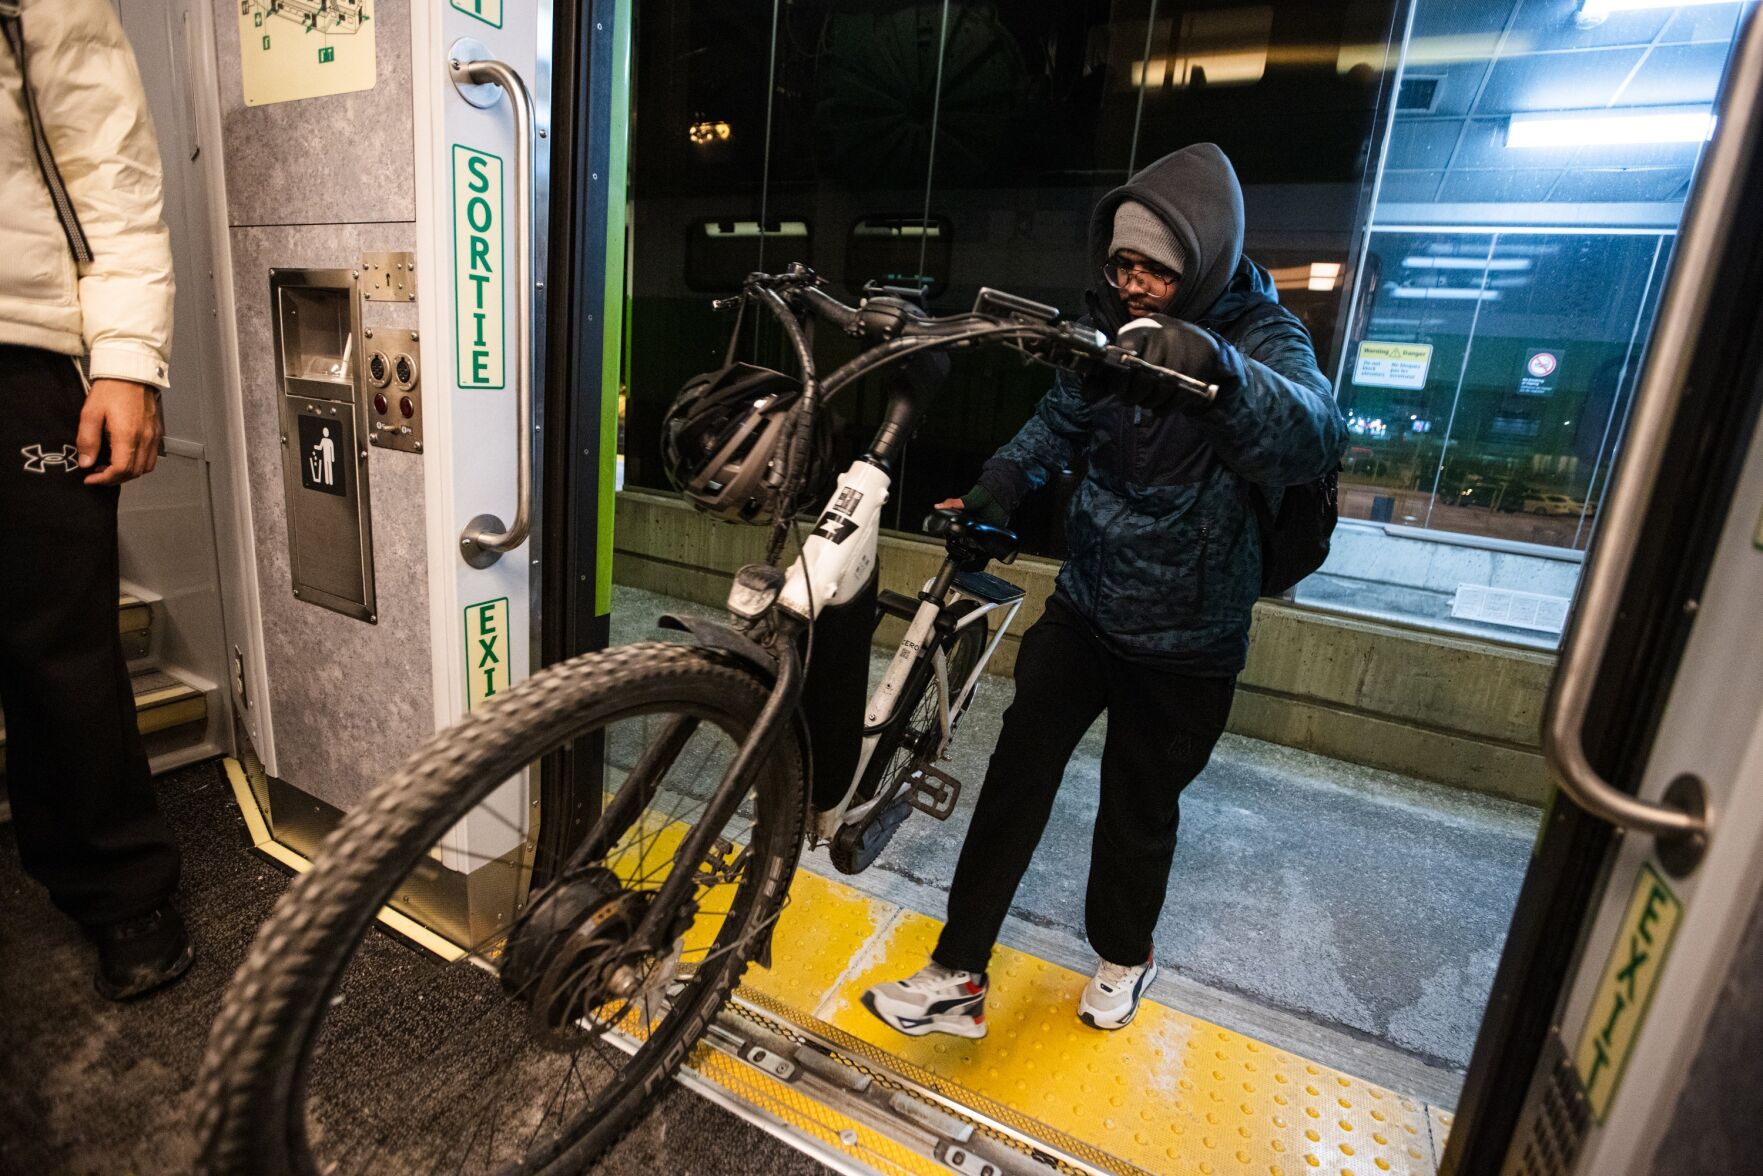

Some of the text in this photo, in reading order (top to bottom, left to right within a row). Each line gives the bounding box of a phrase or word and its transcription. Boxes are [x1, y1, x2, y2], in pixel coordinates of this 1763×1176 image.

[467, 156, 493, 384] SORTIE
[1364, 347, 1426, 357] Warning Danger
[478, 603, 500, 703] EXI
[1586, 884, 1668, 1092] EXIT
